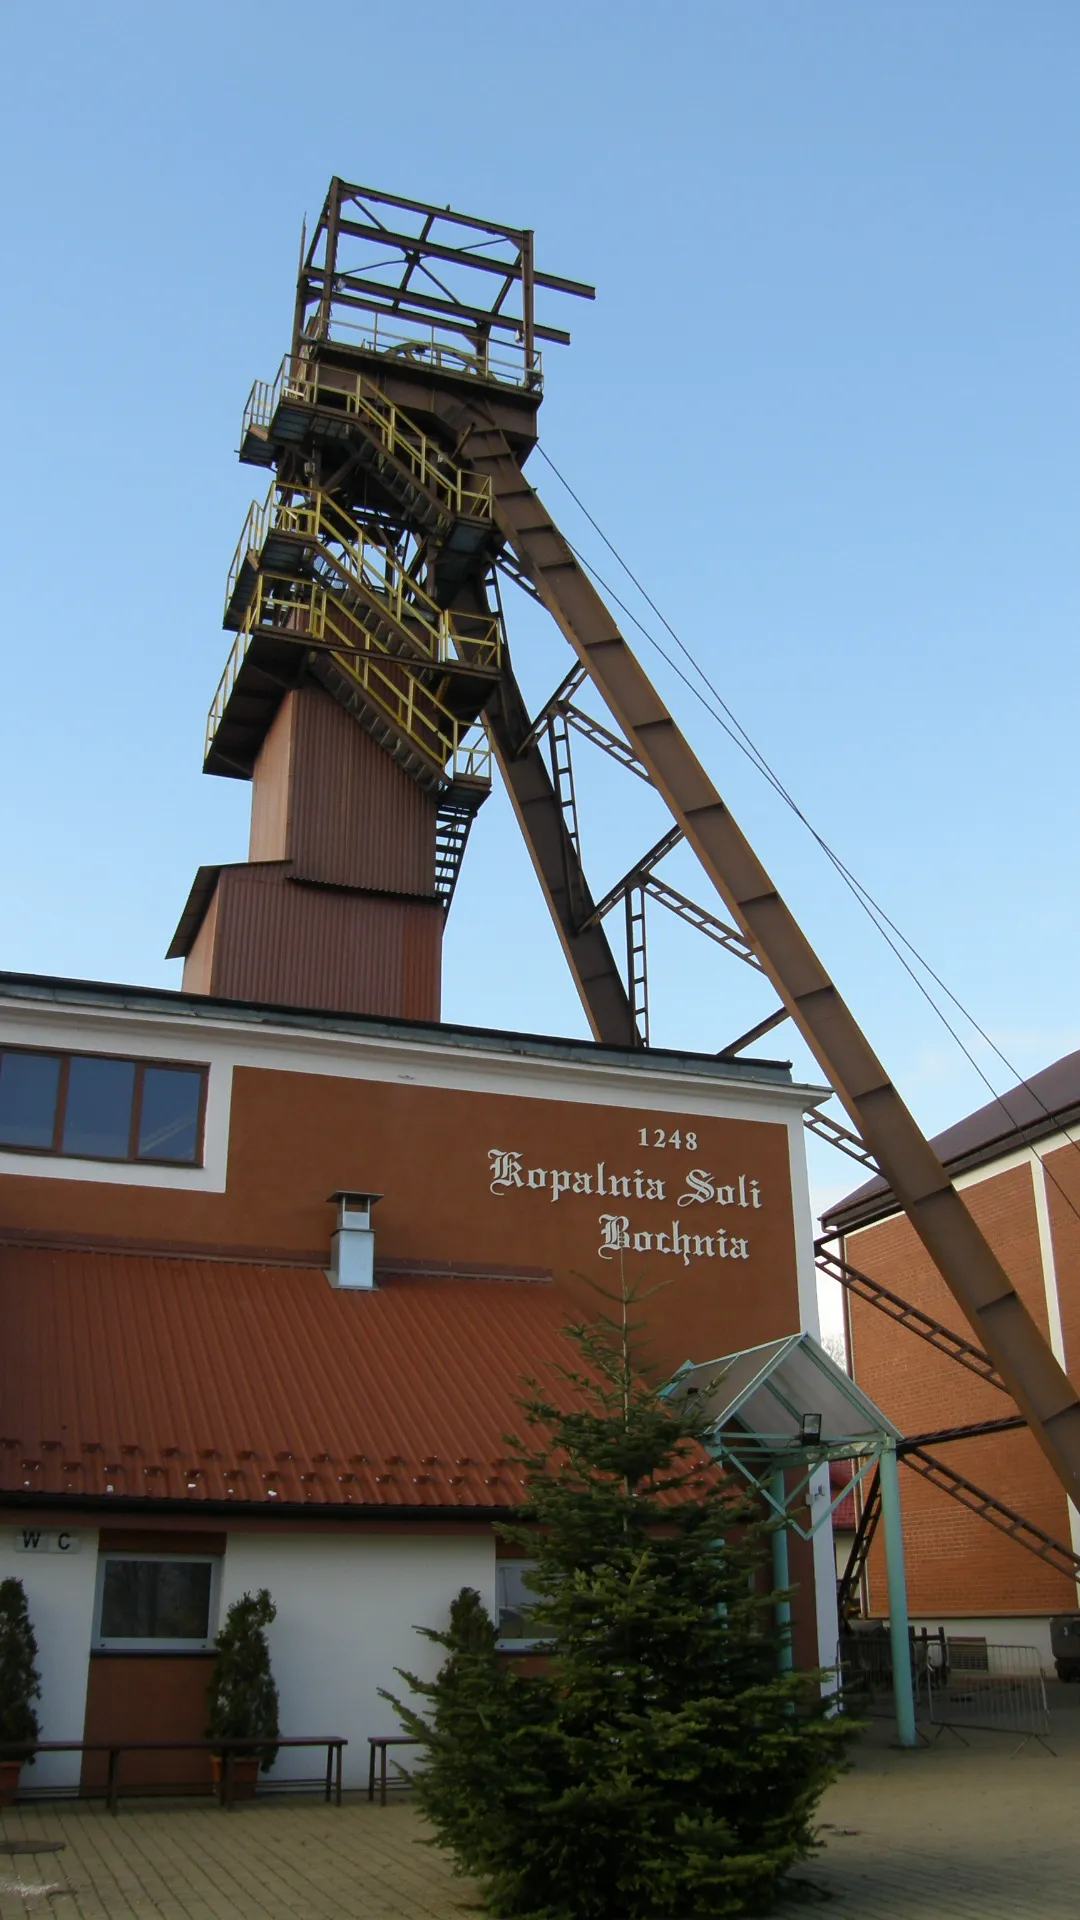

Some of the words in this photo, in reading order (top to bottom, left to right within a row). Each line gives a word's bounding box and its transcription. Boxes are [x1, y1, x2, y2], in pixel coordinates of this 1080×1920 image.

[638, 1128, 698, 1151] 1248
[487, 1148, 666, 1203] Kopalnia
[677, 1169, 762, 1209] Soli
[598, 1213, 750, 1266] Bochnia
